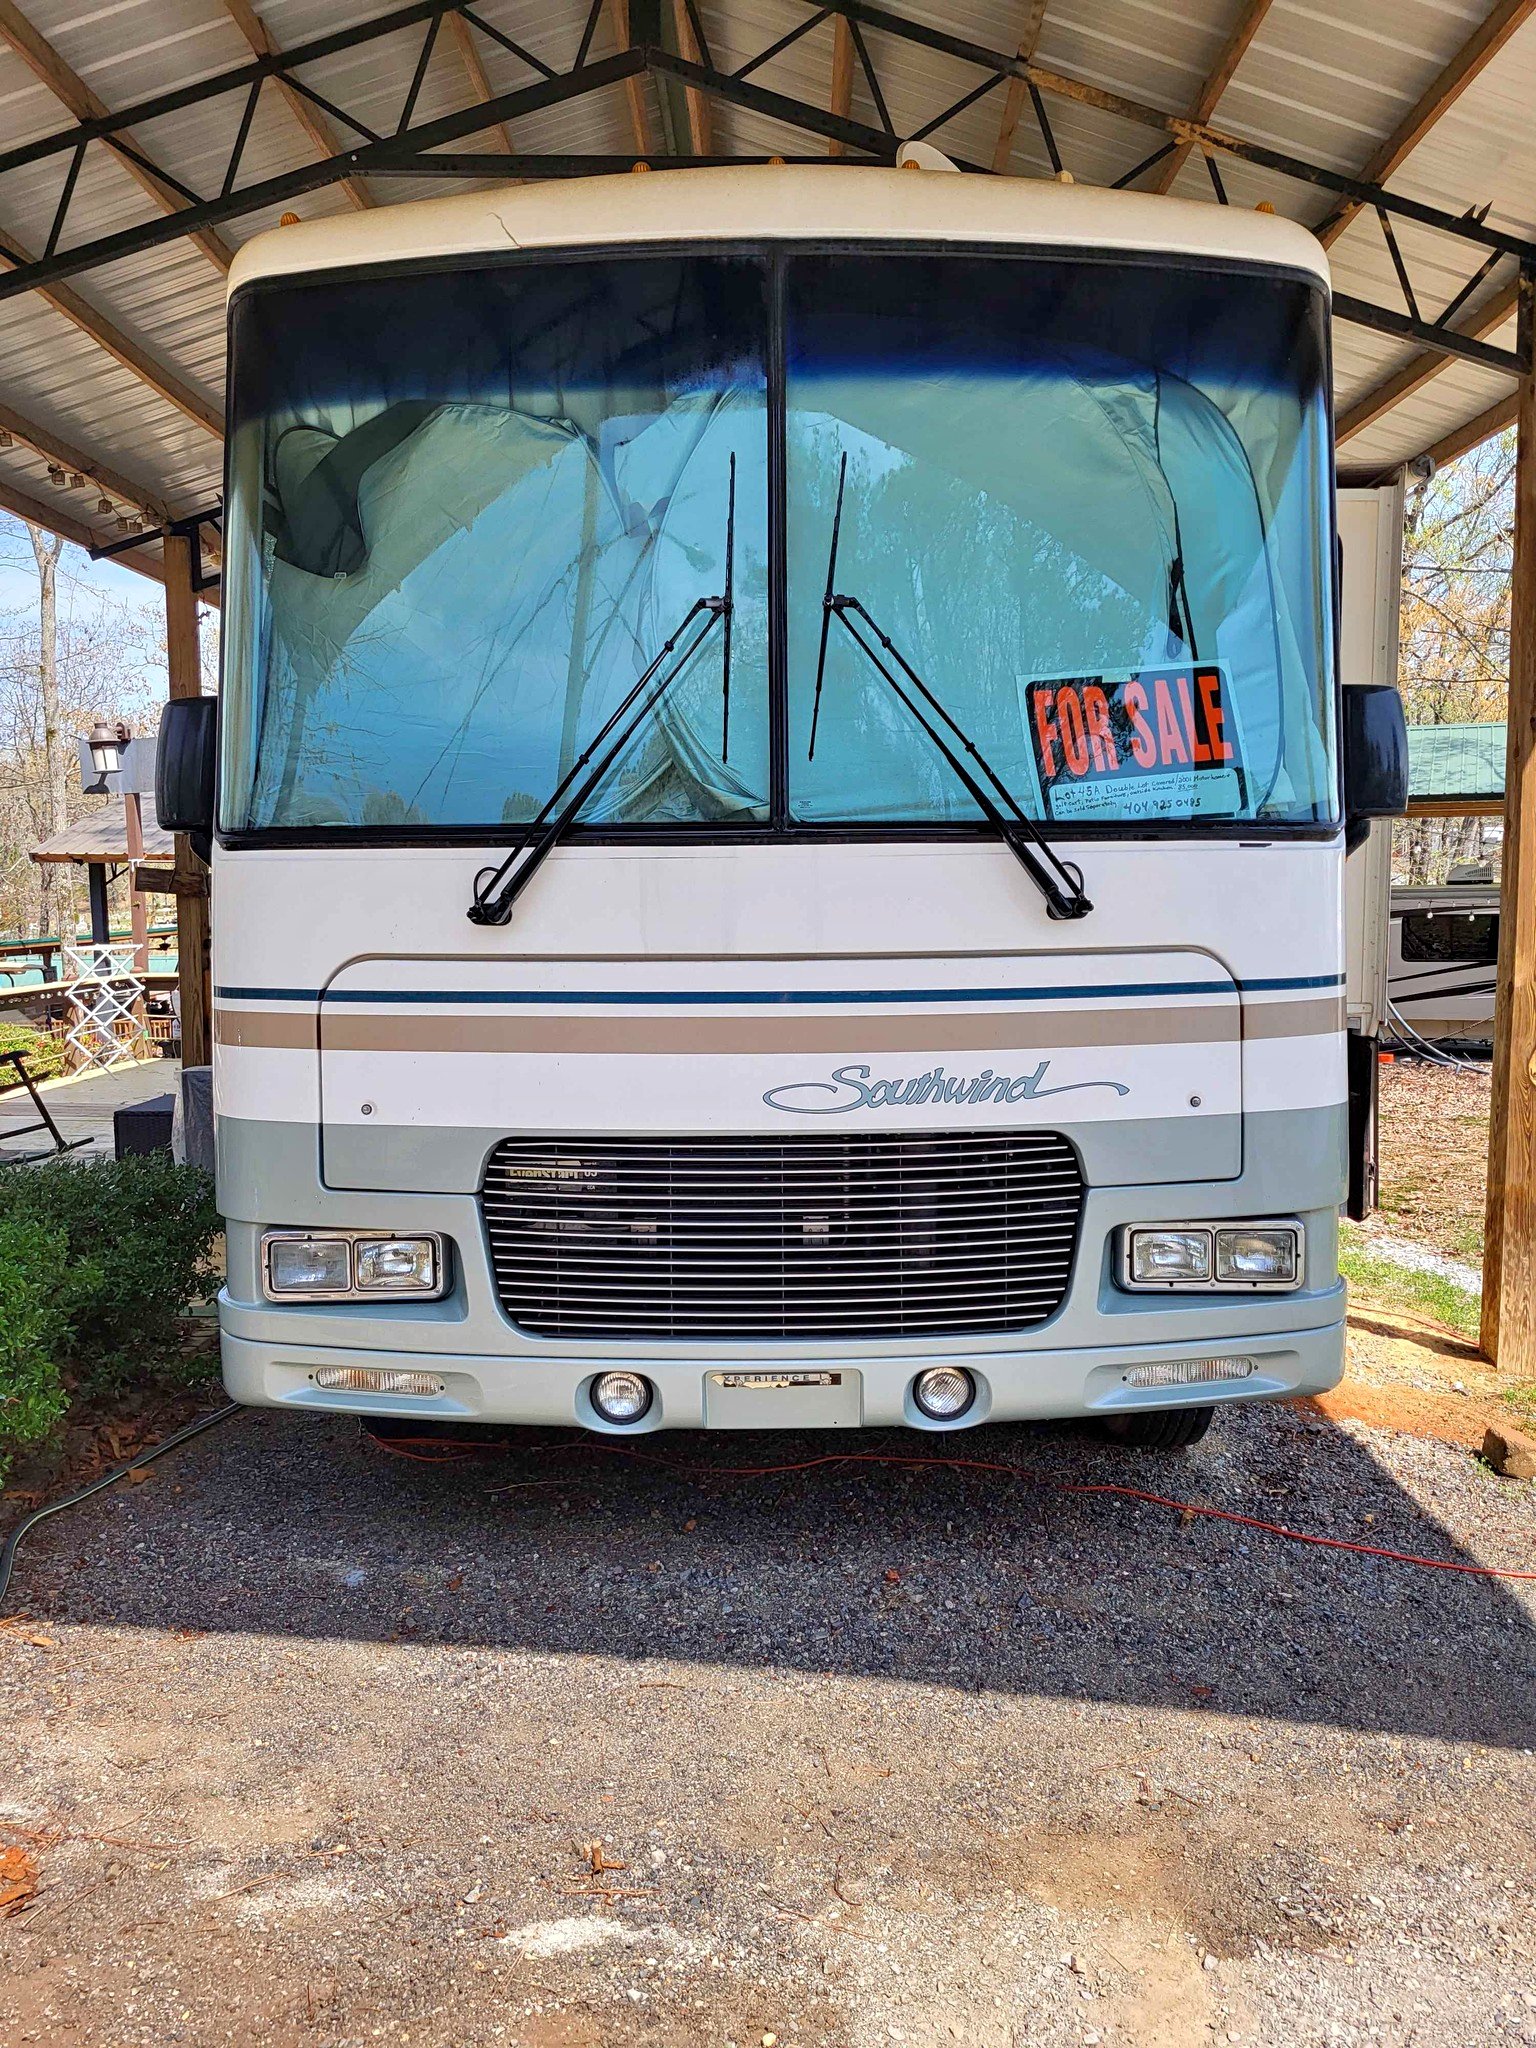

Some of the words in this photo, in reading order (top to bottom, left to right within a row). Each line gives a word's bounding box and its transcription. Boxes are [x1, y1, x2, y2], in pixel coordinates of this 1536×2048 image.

[1033, 685, 1120, 777] FOR
[1124, 675, 1234, 769] SALE
[1055, 789, 1076, 801] Lot
[1105, 783, 1135, 793] Double
[1123, 799, 1149, 814] 404
[1152, 798, 1173, 811] 925
[762, 1060, 1130, 1114] Southwind
